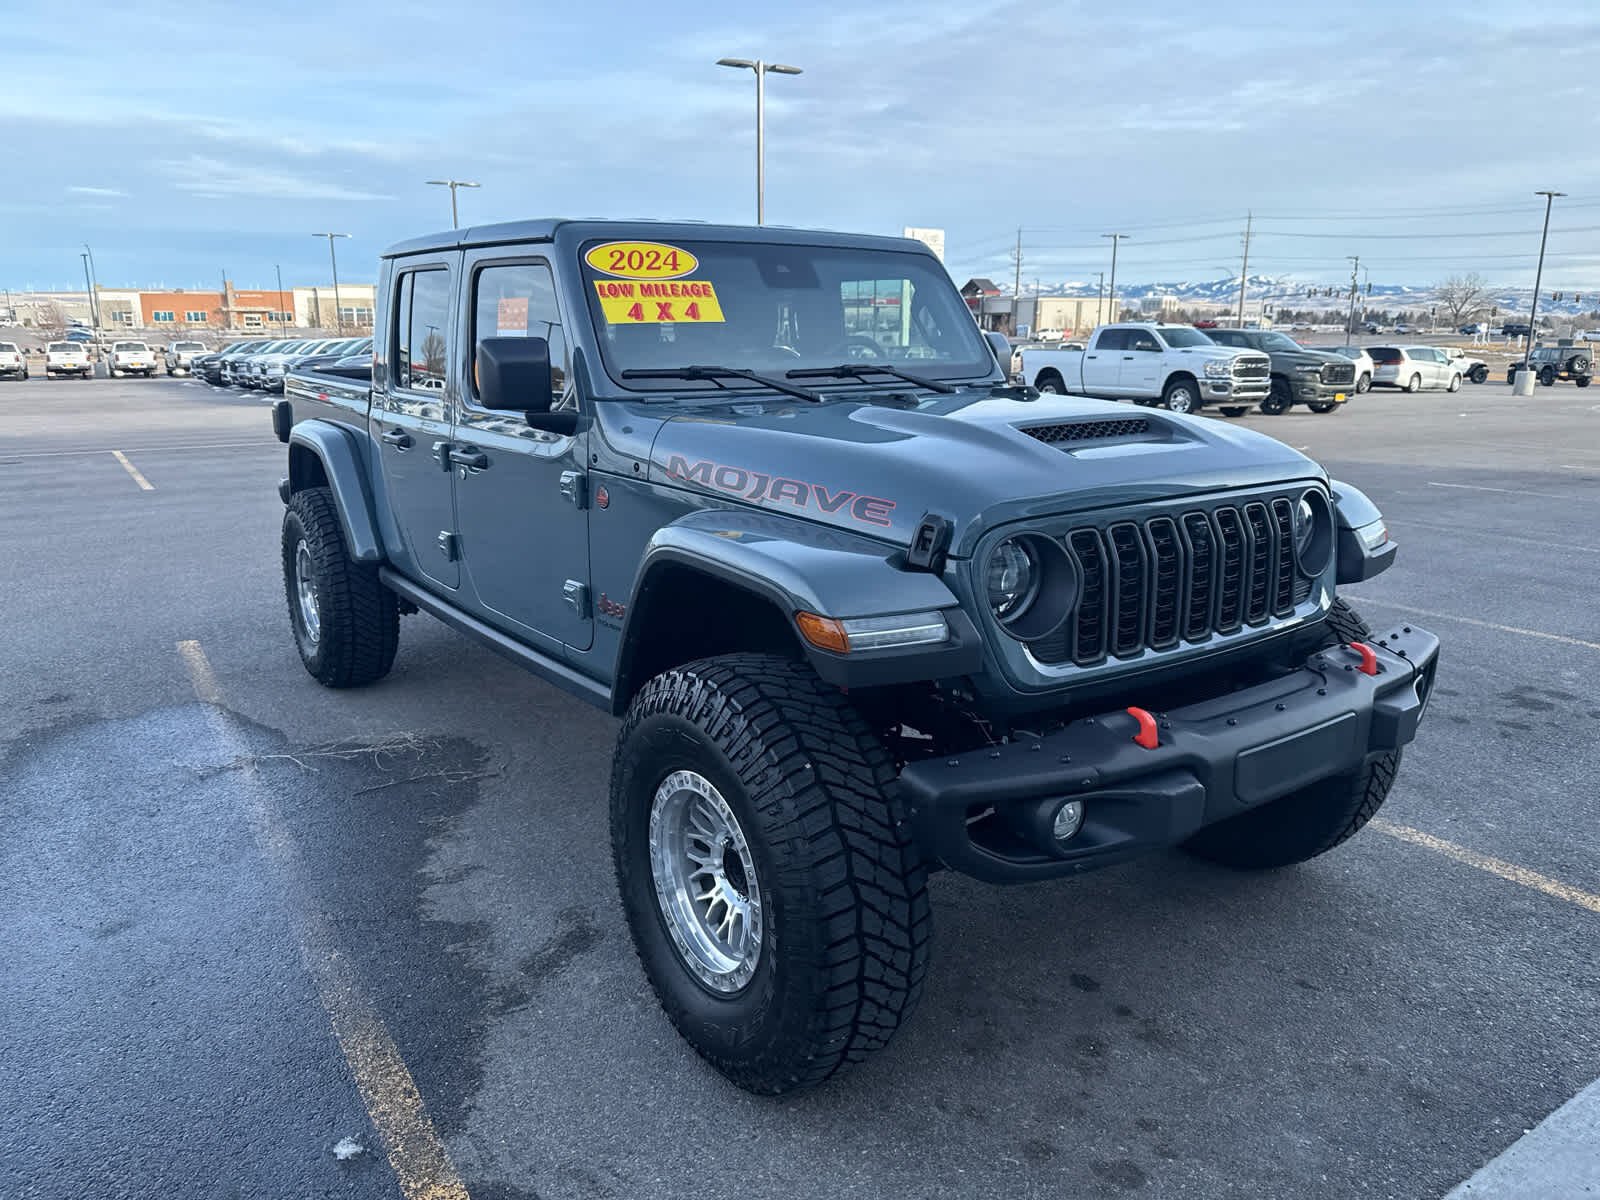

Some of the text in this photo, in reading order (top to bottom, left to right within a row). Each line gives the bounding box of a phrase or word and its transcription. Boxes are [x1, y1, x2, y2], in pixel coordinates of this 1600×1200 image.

[609, 250, 681, 271] 2024
[598, 283, 713, 298] LOW MILEAGE
[627, 302, 700, 321] 4 X 4
[666, 454, 896, 528] MOJAVE
